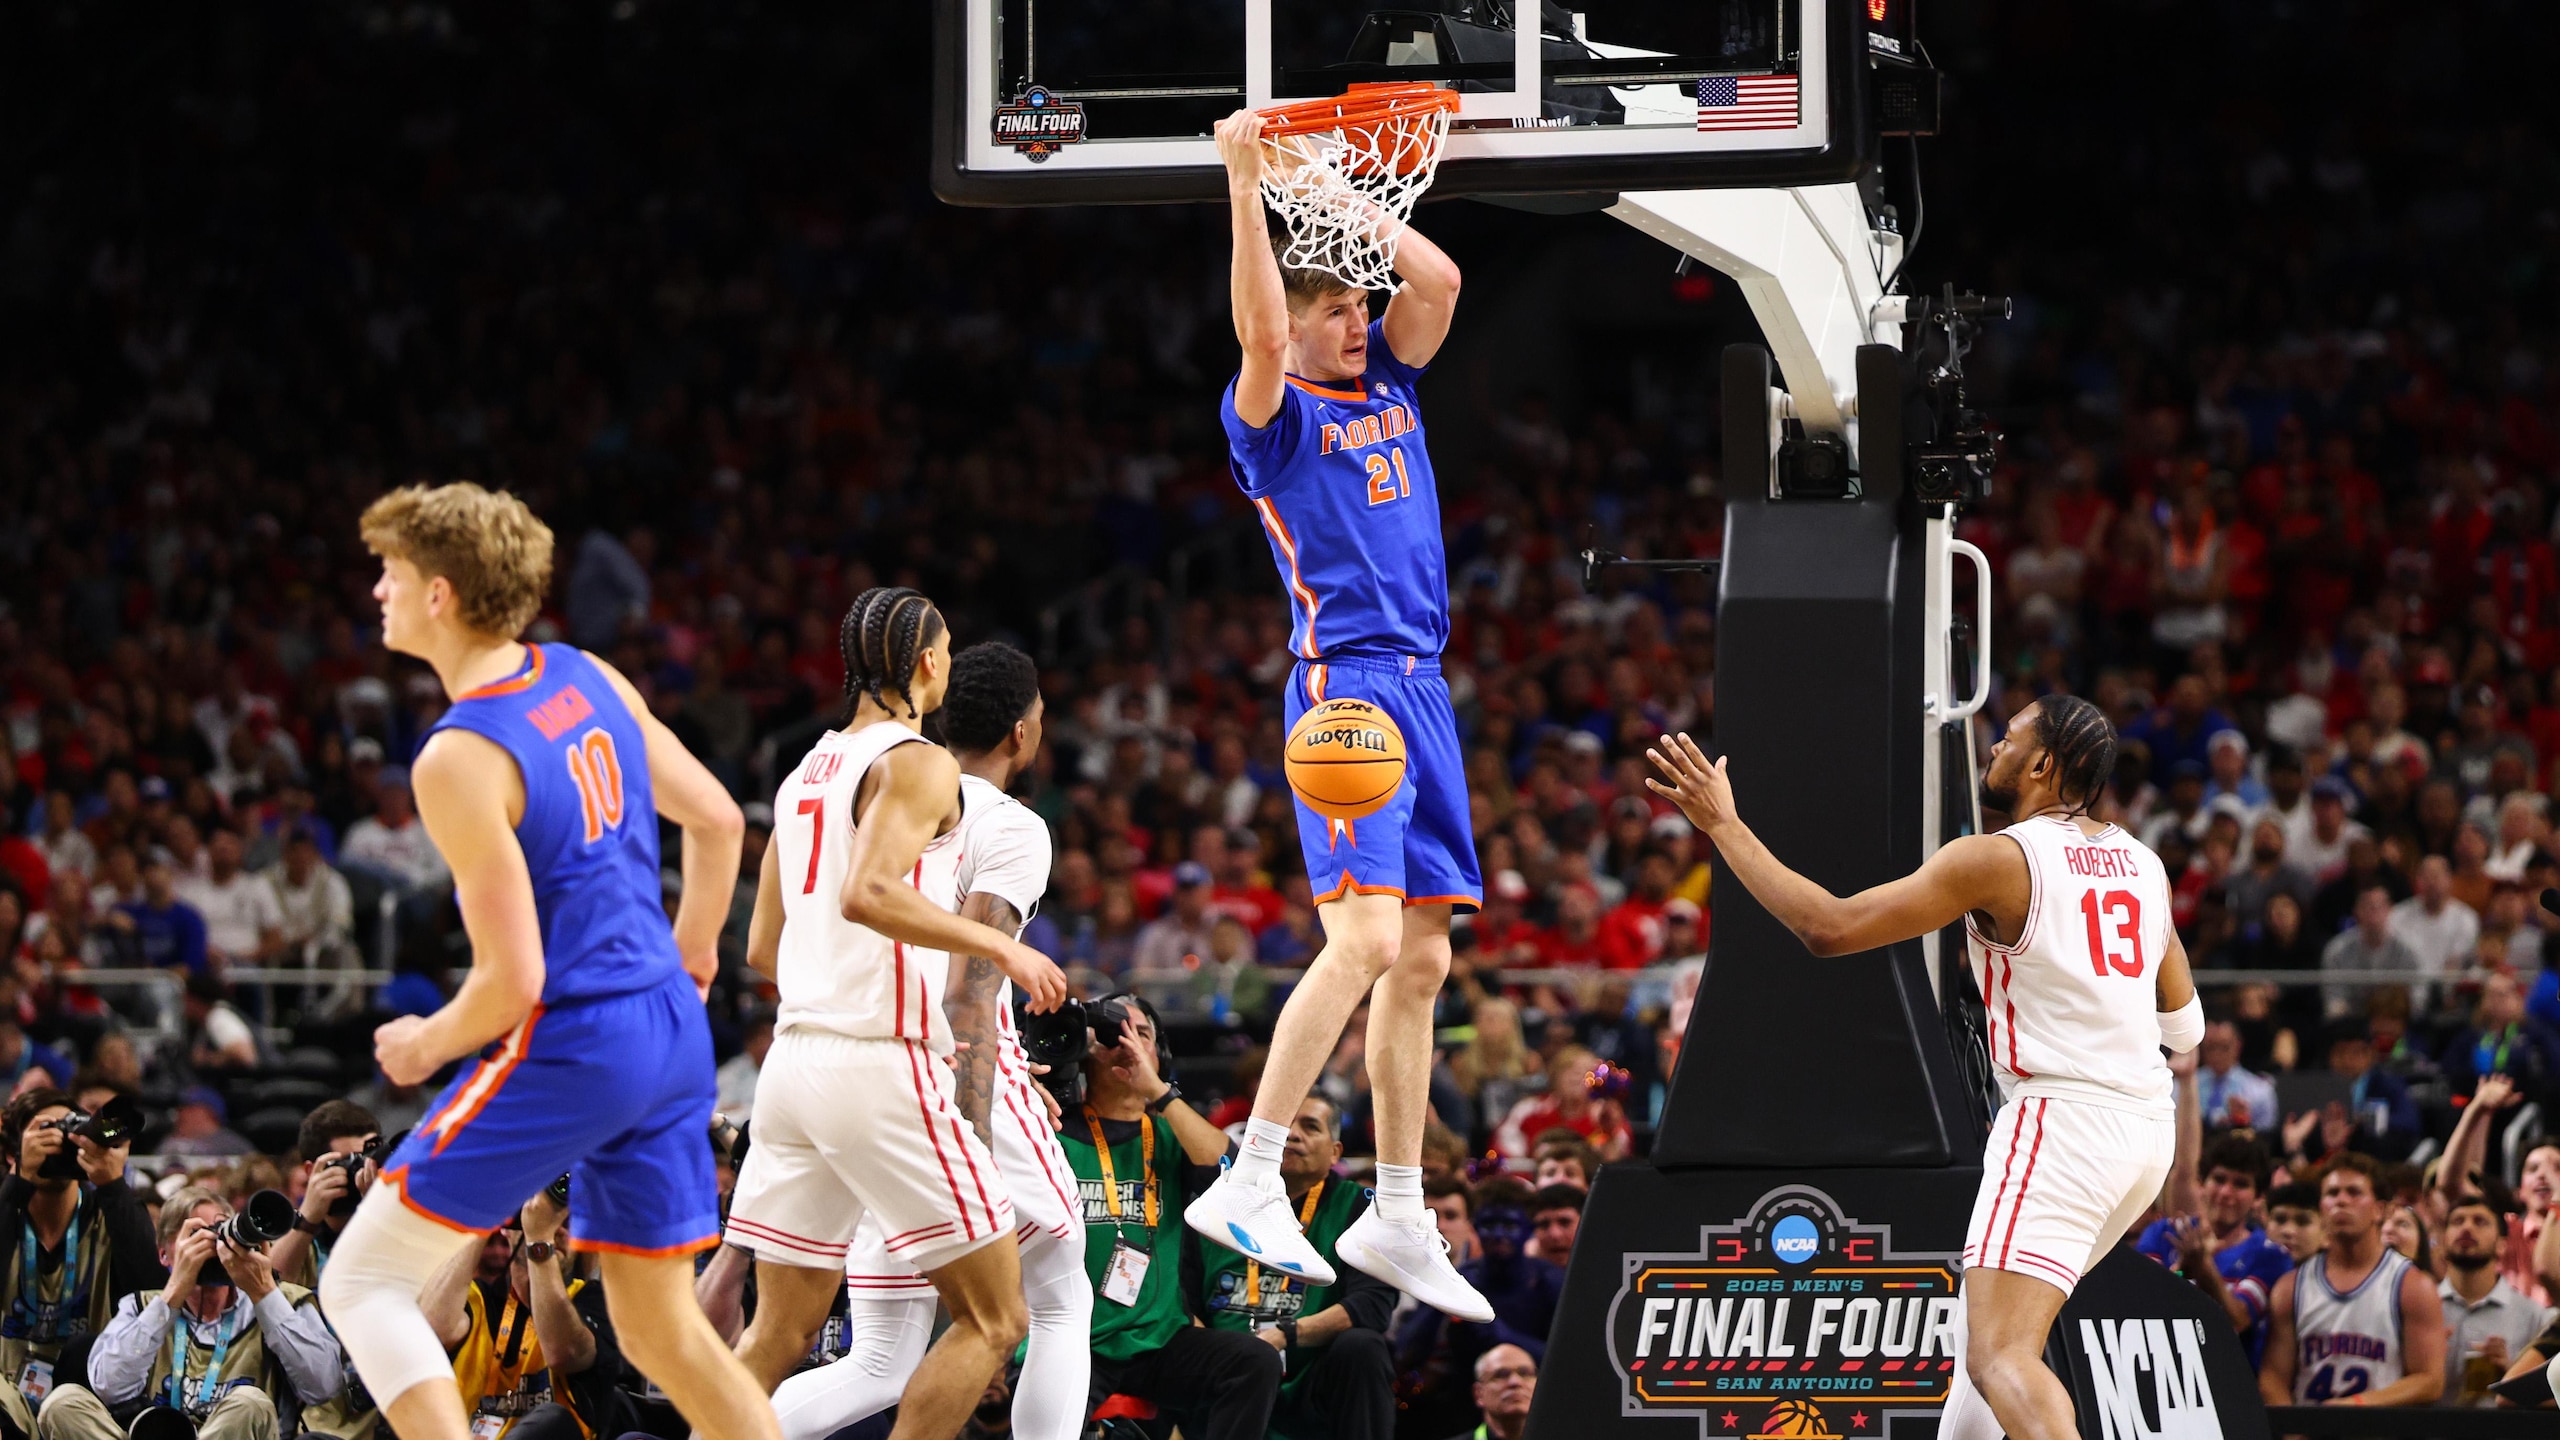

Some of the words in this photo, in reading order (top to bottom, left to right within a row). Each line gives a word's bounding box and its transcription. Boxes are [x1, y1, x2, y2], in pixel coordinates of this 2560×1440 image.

[997, 114, 1039, 132] FINAL
[1040, 113, 1081, 131] FOUR
[1320, 402, 1418, 456] FLORIDA
[1365, 447, 1411, 506] 21
[1316, 702, 1374, 716] NCAA
[1306, 728, 1388, 753] Wilson
[566, 726, 625, 845] 10
[797, 796, 825, 894] 7
[2064, 846, 2139, 878] ROBERTS
[2081, 888, 2144, 978] 13
[1079, 1182, 1134, 1201] MACH
[1775, 1237, 1818, 1252] NCAA
[1726, 1279, 1785, 1292] 2025
[1792, 1279, 1864, 1292] MEN'S
[1635, 1297, 1797, 1358] FINAL
[1805, 1297, 1959, 1358] FOUR
[2304, 1333, 2386, 1367] FLORIDA
[1715, 1377, 1762, 1390] SAN
[1769, 1377, 1874, 1390] ANTONIO
[2078, 1318, 2225, 1440] NCAA
[2304, 1362, 2369, 1402] 42
